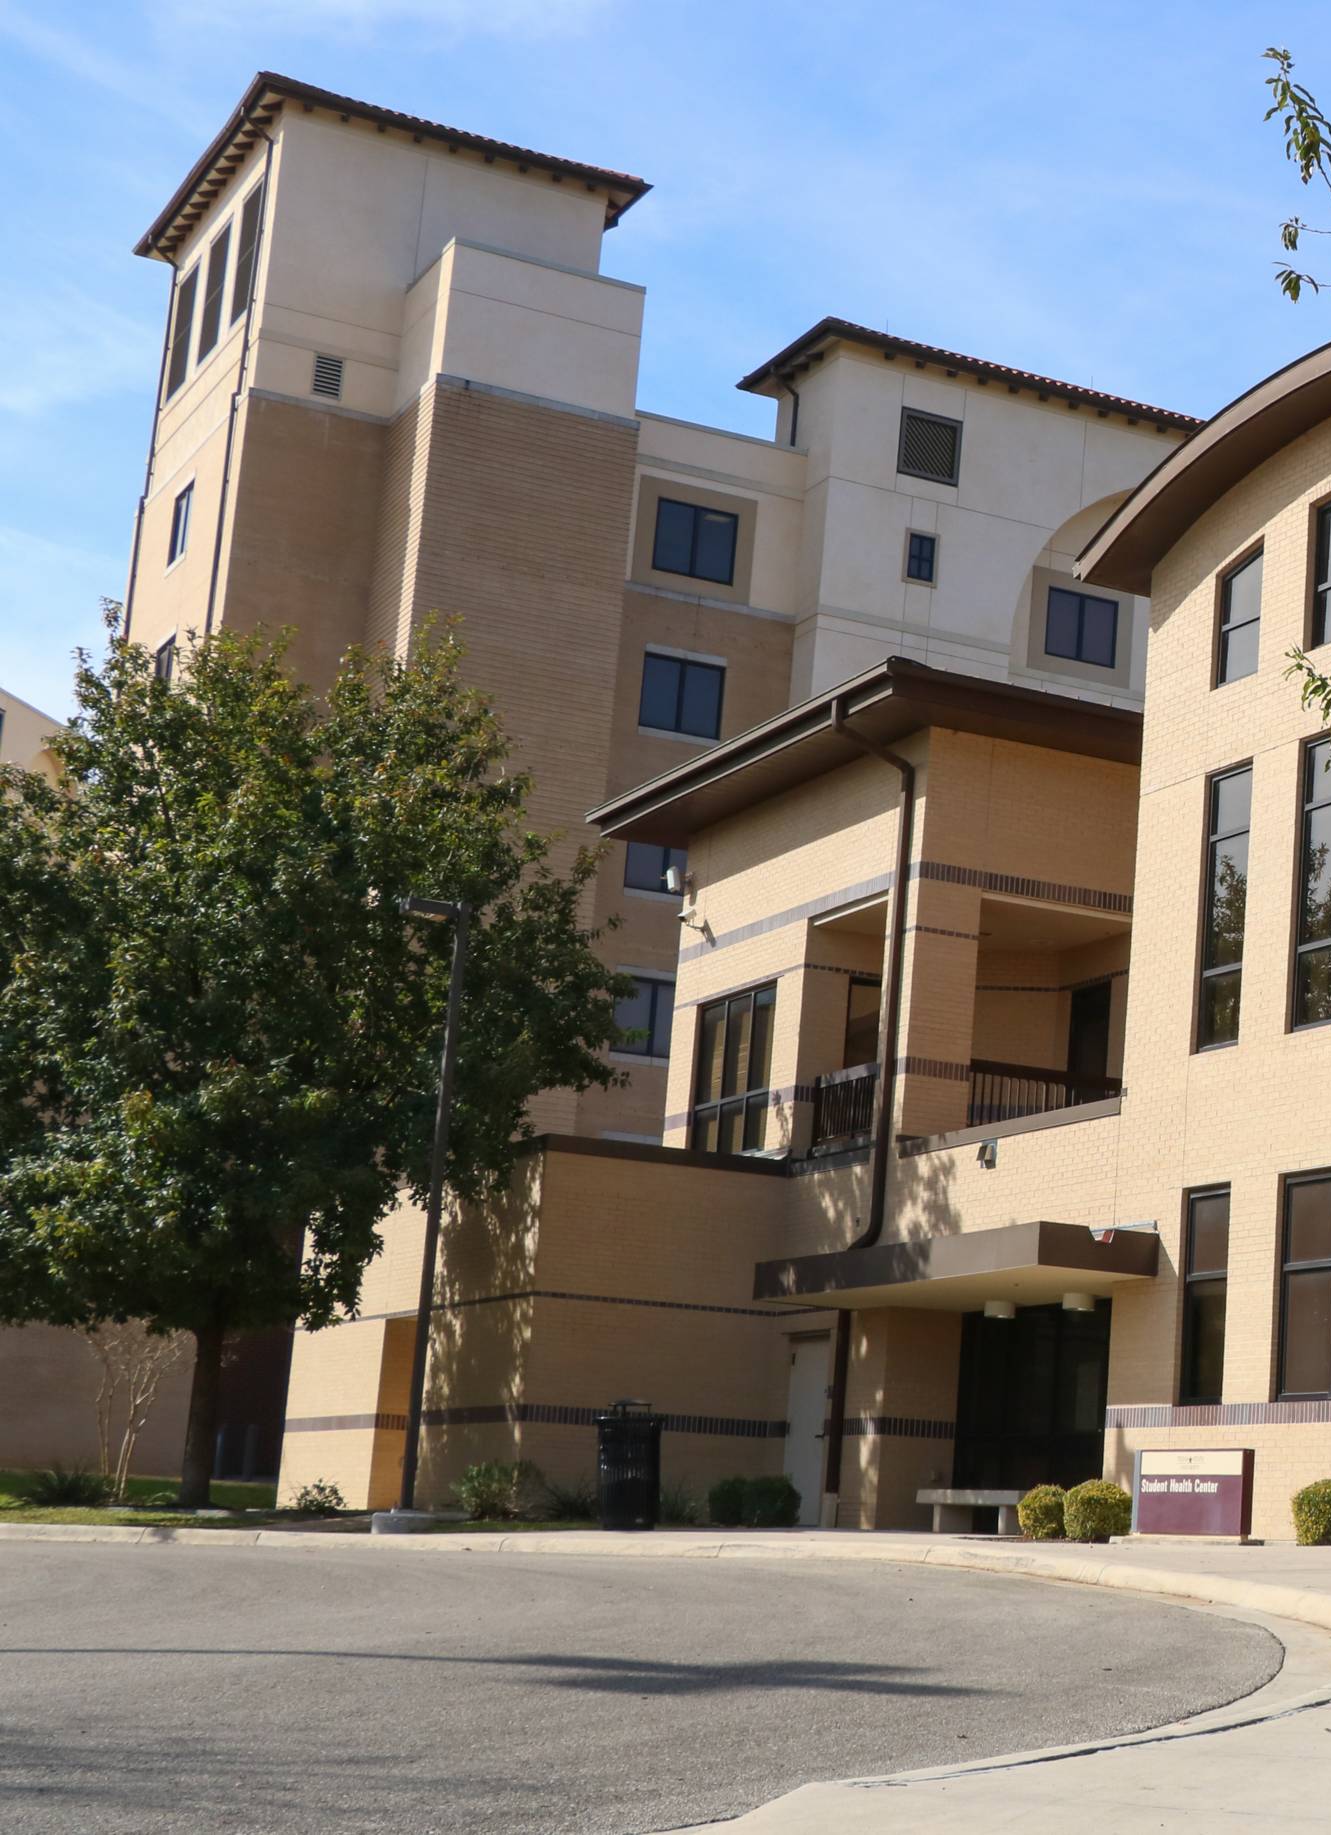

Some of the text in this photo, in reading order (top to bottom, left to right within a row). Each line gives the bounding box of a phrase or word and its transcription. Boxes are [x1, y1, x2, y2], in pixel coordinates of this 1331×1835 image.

[1141, 1479, 1218, 1493] Student Health Center
